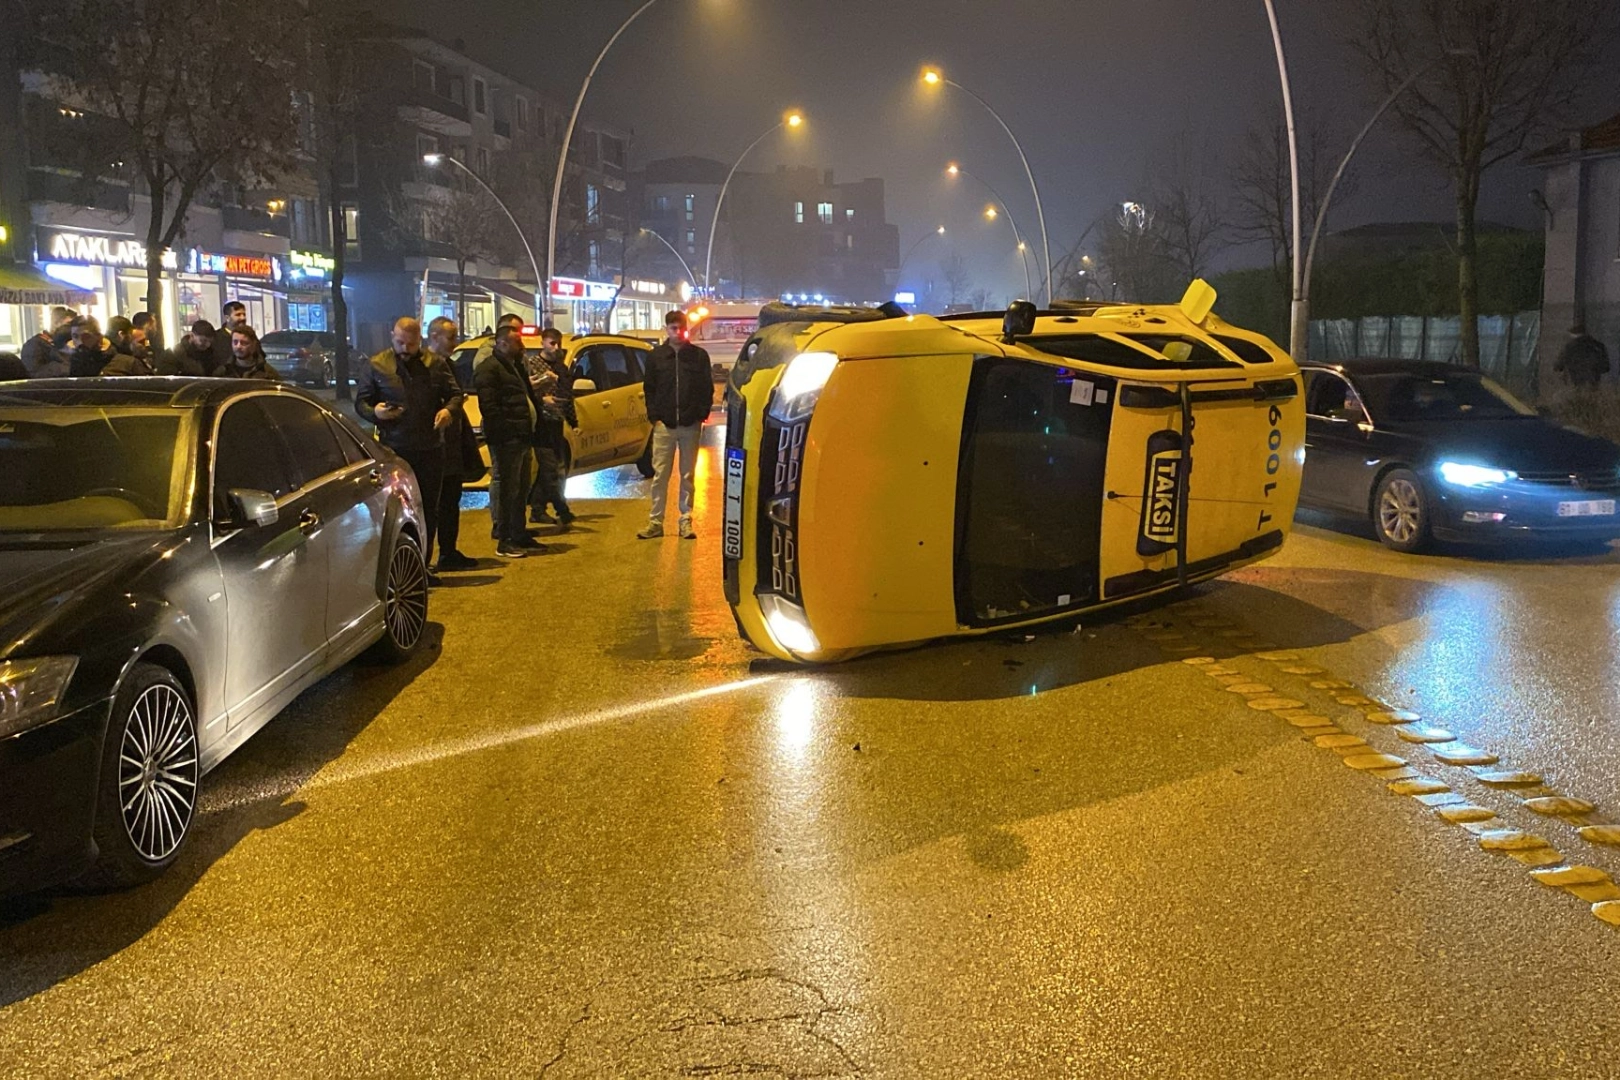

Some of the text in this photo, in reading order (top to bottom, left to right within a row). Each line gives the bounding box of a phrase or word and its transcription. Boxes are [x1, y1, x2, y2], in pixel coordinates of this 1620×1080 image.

[239, 258, 251, 273] PET
[730, 459, 742, 479] 81
[1257, 404, 1282, 531] T 1009
[728, 495, 740, 504] T
[727, 519, 740, 556] 1009
